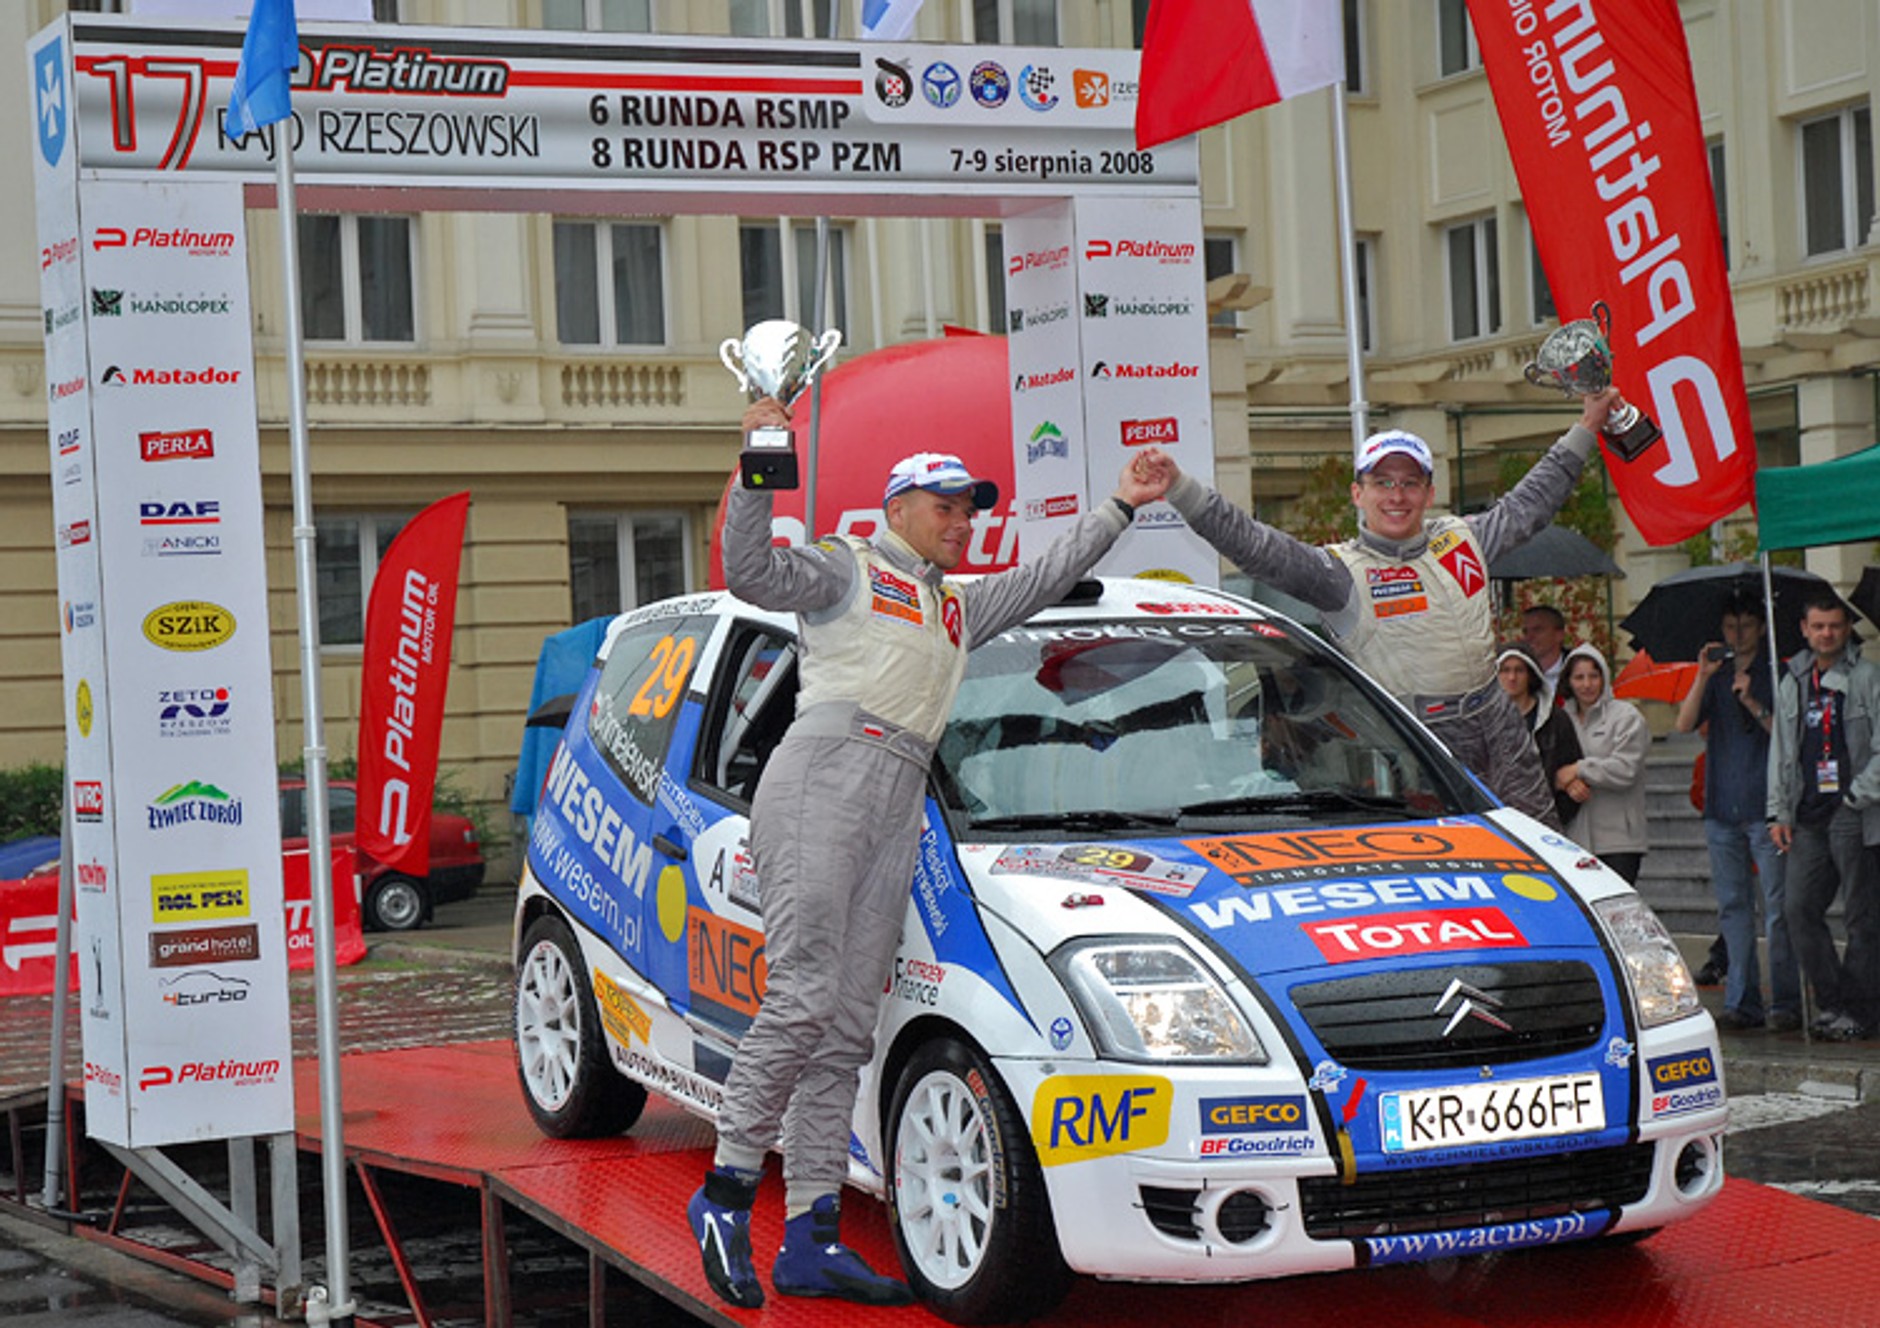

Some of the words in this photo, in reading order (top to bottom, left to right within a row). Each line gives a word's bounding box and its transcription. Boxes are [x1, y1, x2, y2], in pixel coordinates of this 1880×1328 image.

[319, 46, 511, 97] Platinum
[89, 56, 208, 171] 17
[589, 95, 609, 126] 6
[621, 96, 745, 129] RUNDA
[756, 99, 850, 131] RSMP
[322, 110, 541, 157] RZESZOWSKI
[591, 138, 611, 168] 8
[624, 138, 747, 172] RUNDA
[759, 141, 821, 173] RSP
[832, 142, 901, 172] PZM
[950, 149, 988, 173] 7-9
[995, 150, 1093, 180] sierpnia
[1101, 152, 1155, 175] 2008
[132, 227, 235, 248] Platinum
[1115, 239, 1196, 257] Platinum
[130, 300, 230, 314] HANDLOPEX
[132, 366, 242, 385] Matador
[1027, 366, 1076, 389] Matador
[1115, 361, 1200, 378] Matador
[140, 501, 220, 517] DAF
[426, 581, 440, 605] OIL
[421, 607, 438, 664] MOTOR
[384, 568, 428, 772] Platinum
[628, 634, 696, 719] 29
[159, 689, 215, 702] ZETO
[546, 737, 654, 900] WESEM
[1075, 847, 1136, 869] 29
[1220, 831, 1455, 866] NEO
[708, 847, 725, 893] A
[1188, 875, 1496, 930] WESEM
[159, 939, 210, 958] grand
[211, 935, 252, 951] hotel
[288, 933, 315, 949] OIL
[1315, 918, 1516, 953] TOTAL
[162, 988, 248, 1006] 4turbo
[178, 1059, 280, 1083] Platinum
[1655, 1057, 1712, 1083] GEFCO
[1049, 1087, 1157, 1149] RMF
[1209, 1104, 1301, 1126] GEFCO
[1480, 1080, 1594, 1133] 666FF
[1200, 1135, 1315, 1154] BFGoodrich
[1365, 1210, 1586, 1258] www.acus.pl
